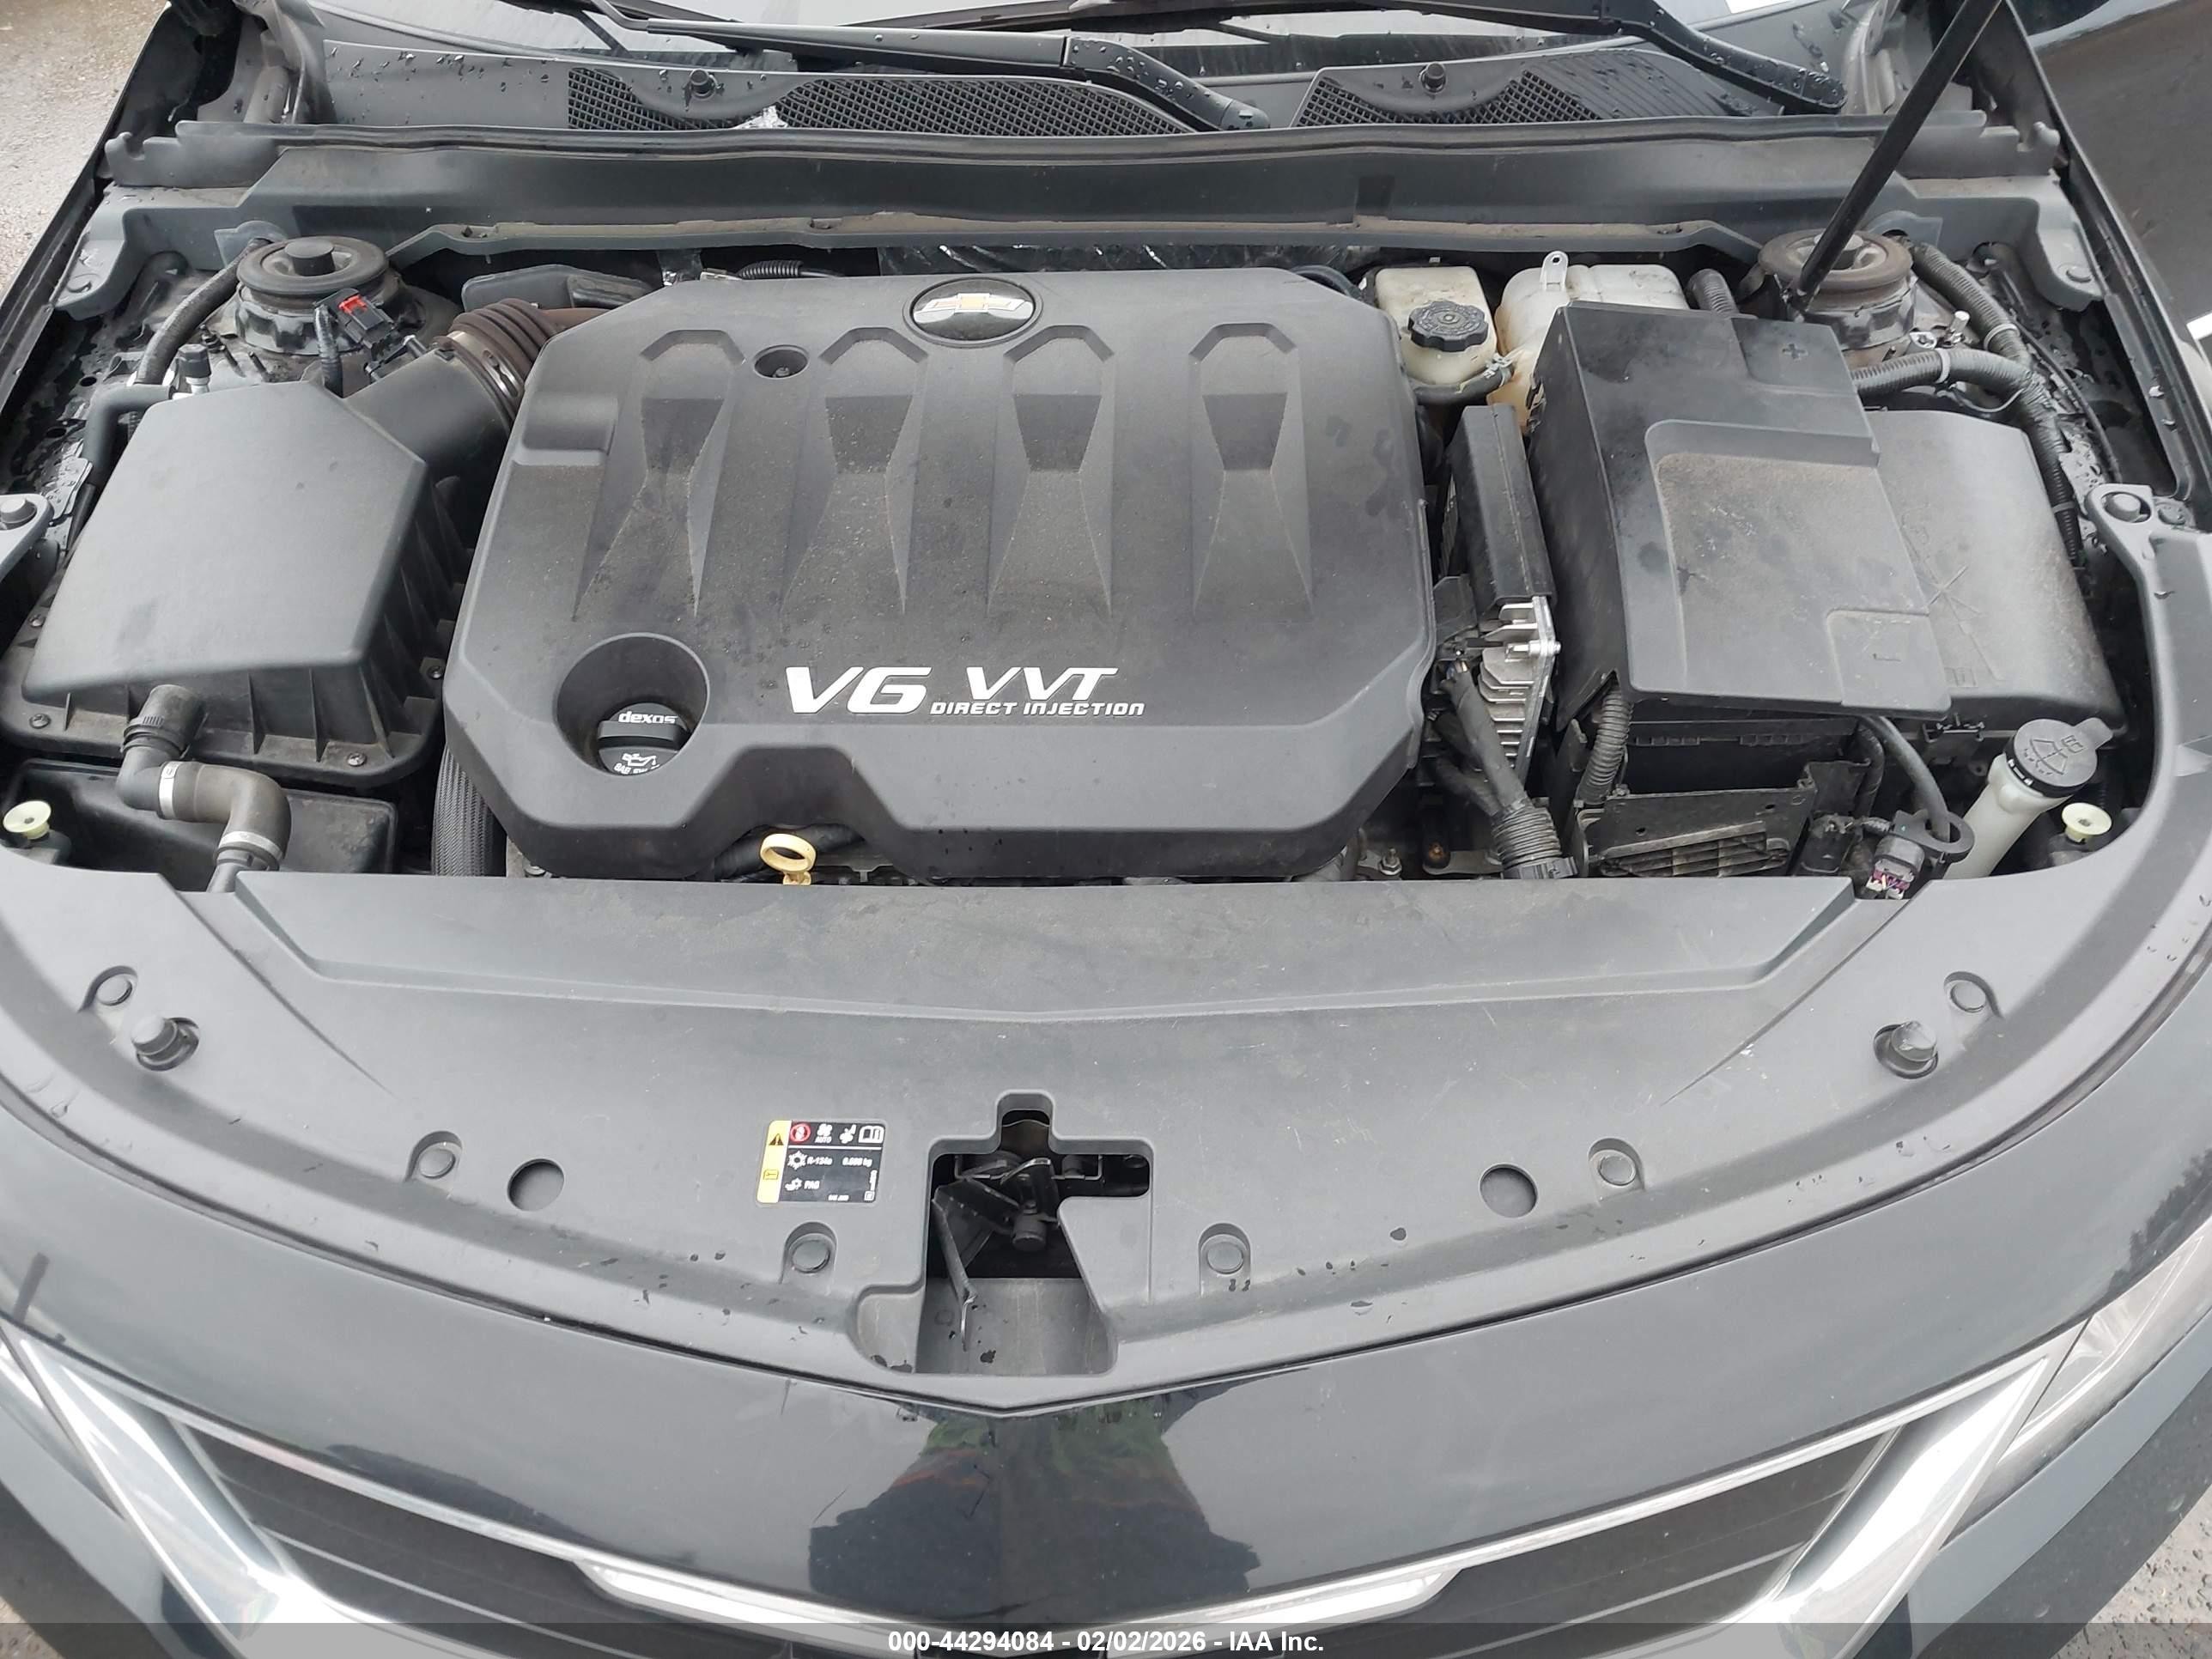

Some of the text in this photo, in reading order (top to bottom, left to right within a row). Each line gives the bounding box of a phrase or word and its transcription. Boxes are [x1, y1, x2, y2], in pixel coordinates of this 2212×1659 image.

[786, 666, 1119, 714] V6 VVT
[930, 702, 1146, 715] DIRECT INJECTION
[618, 711, 678, 724] dexos
